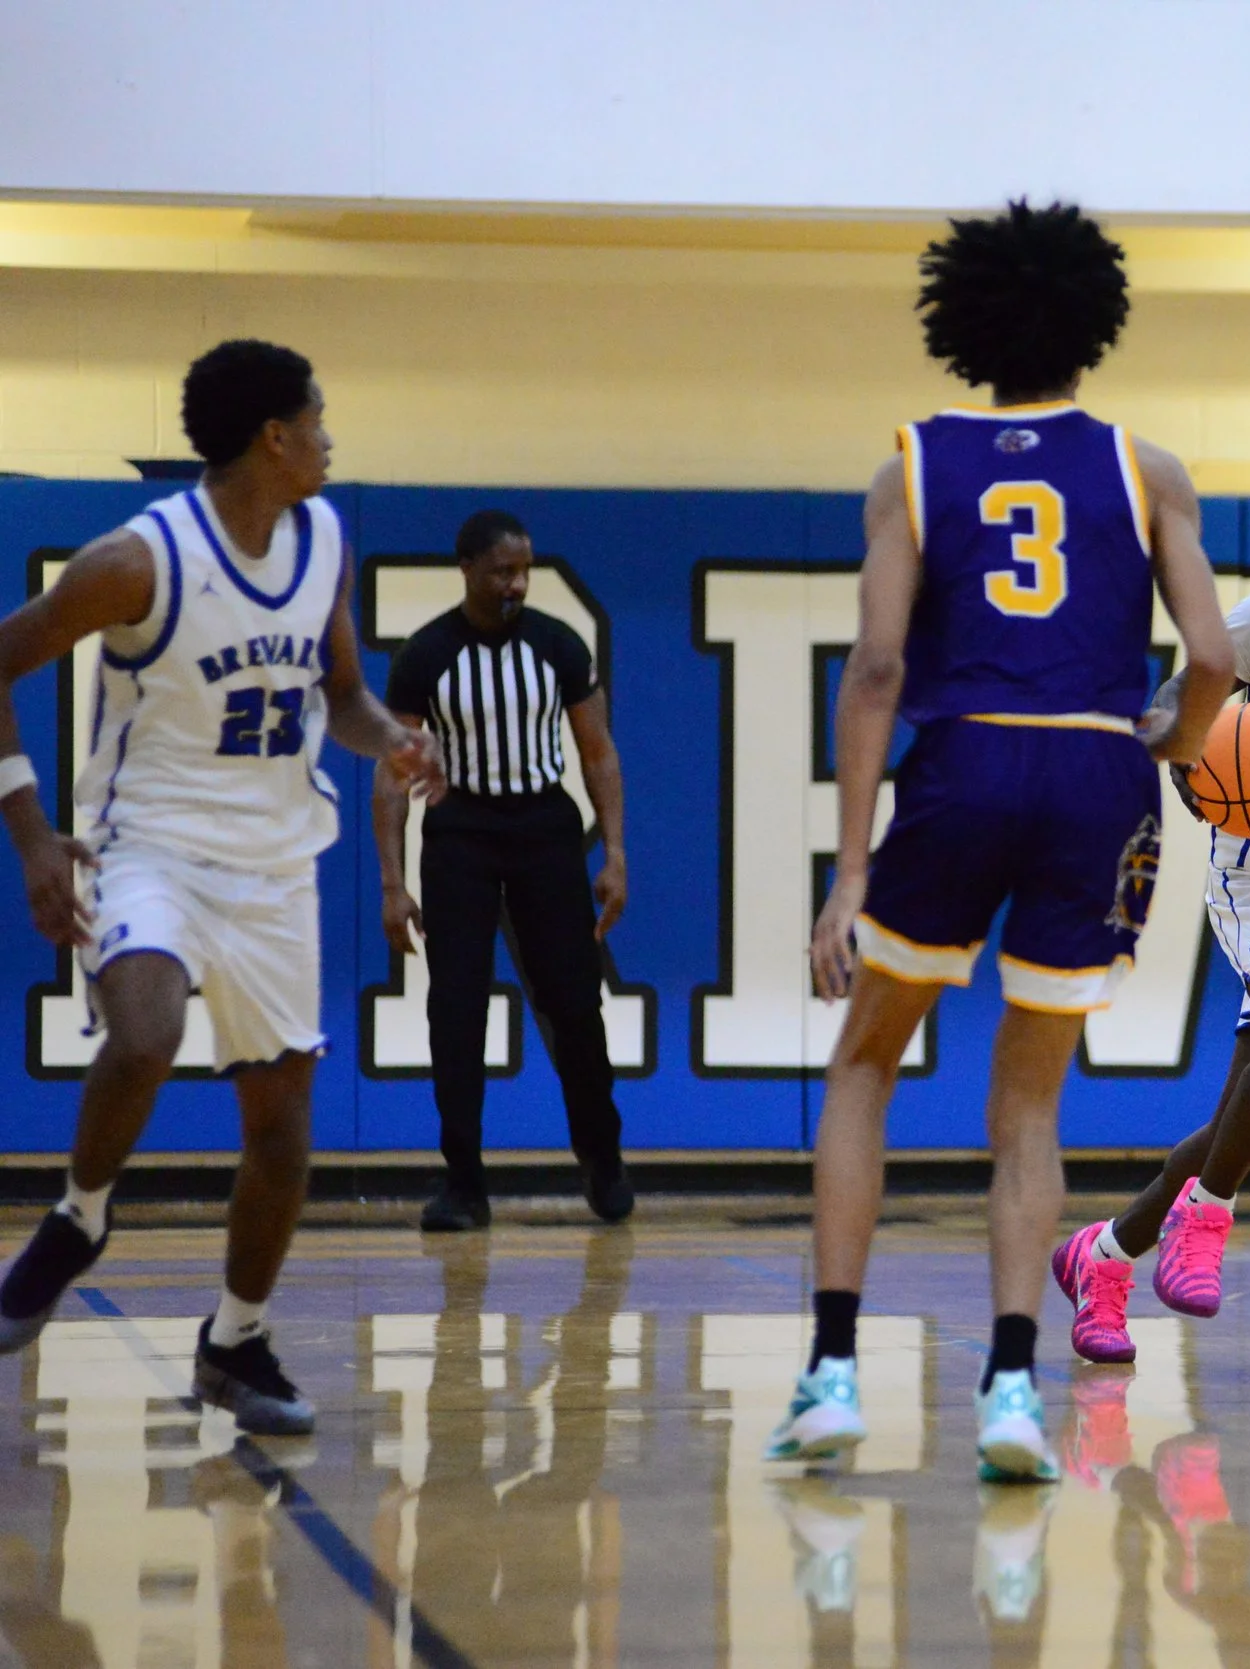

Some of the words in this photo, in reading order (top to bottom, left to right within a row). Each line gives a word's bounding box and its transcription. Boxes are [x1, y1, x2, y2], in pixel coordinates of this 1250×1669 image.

[979, 480, 1068, 618] 3
[196, 634, 314, 684] BREVAR
[214, 686, 305, 758] 23
